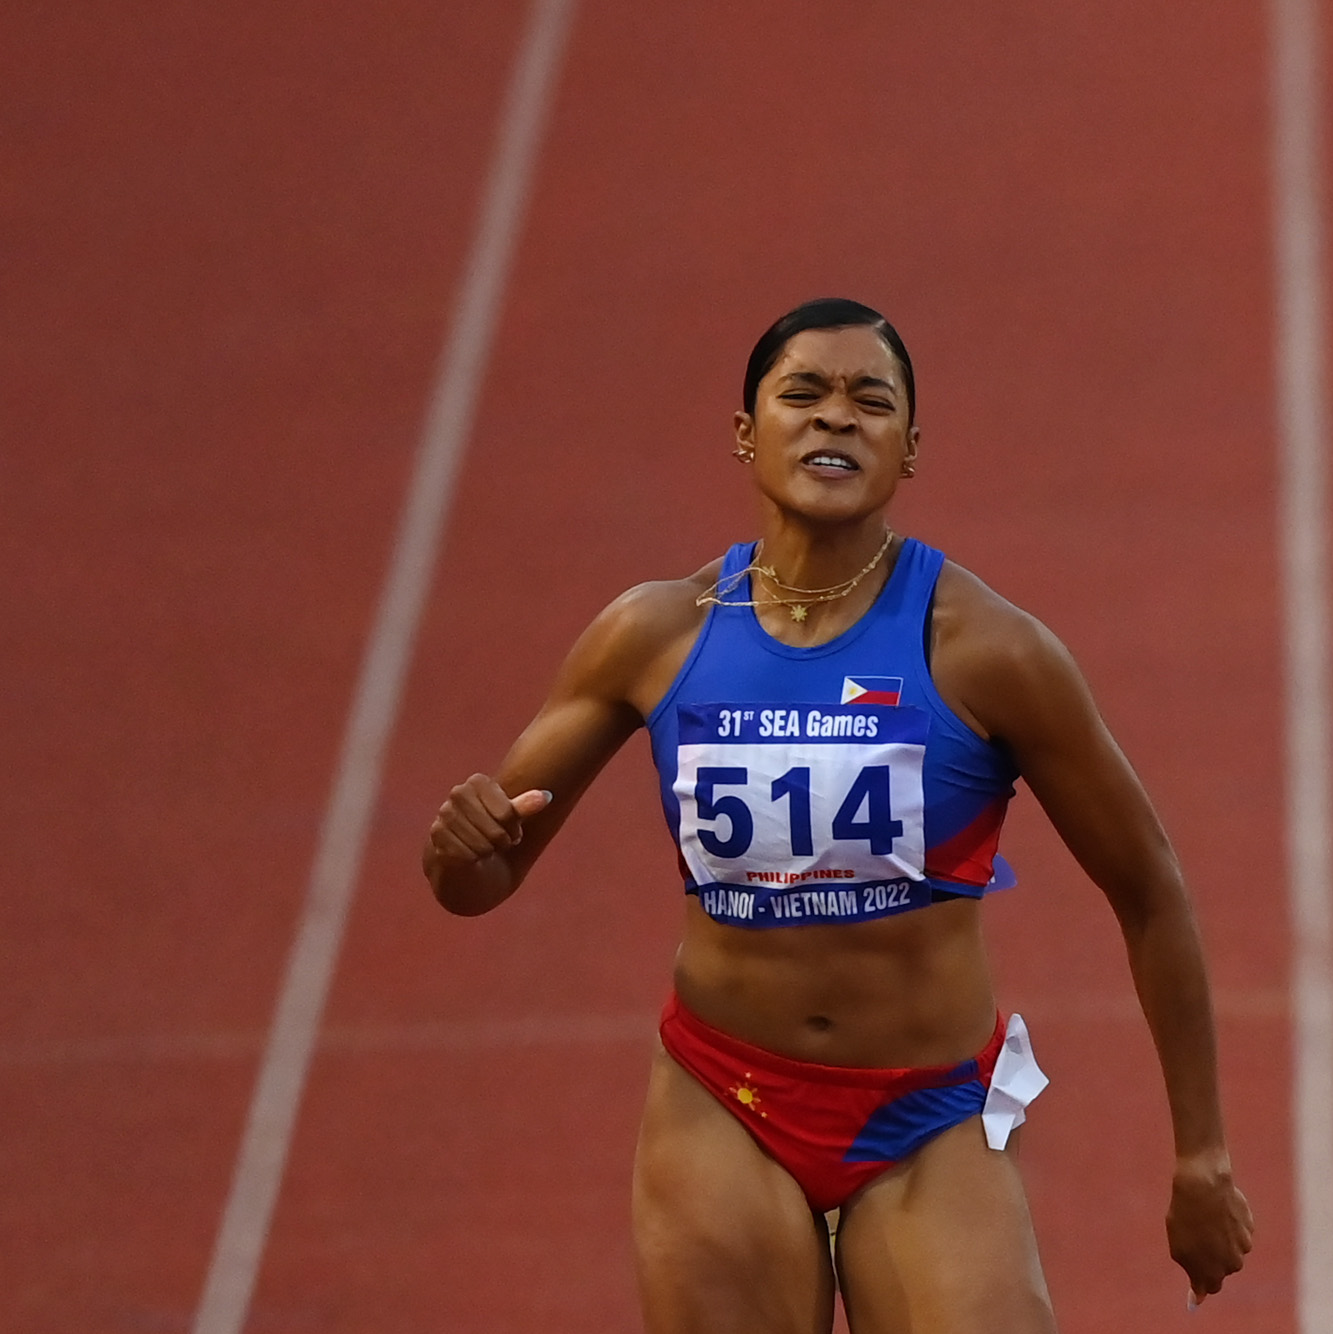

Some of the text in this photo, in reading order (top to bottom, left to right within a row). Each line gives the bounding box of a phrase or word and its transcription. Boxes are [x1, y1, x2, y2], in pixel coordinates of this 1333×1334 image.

[759, 710, 800, 737] SEA
[806, 710, 879, 738] Games
[695, 765, 904, 859] 514
[746, 869, 855, 884] PHILIPPINES
[704, 889, 755, 920] HANOI
[770, 891, 858, 919] VIETNAM
[863, 882, 910, 912] 2022
